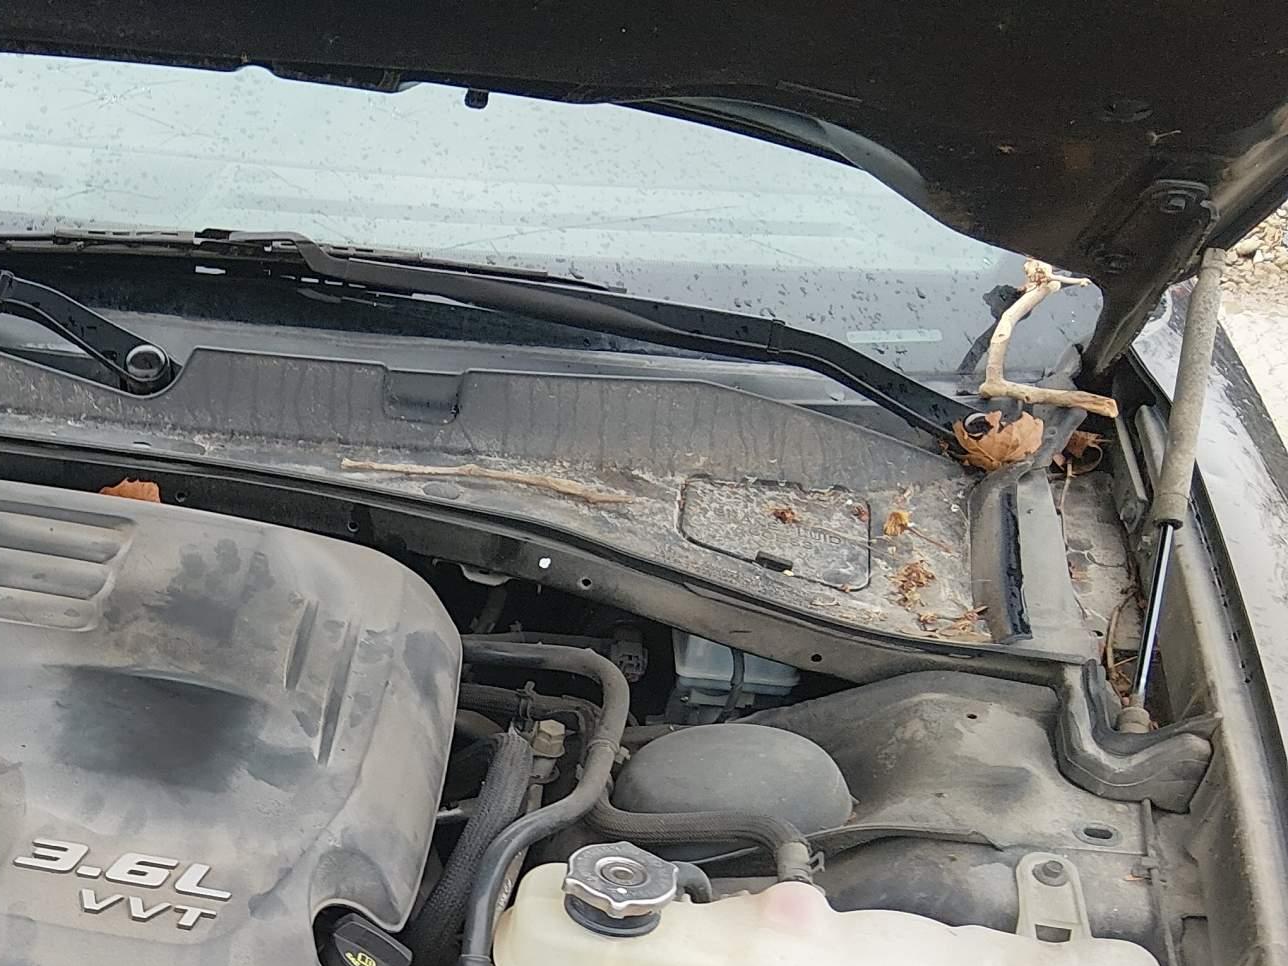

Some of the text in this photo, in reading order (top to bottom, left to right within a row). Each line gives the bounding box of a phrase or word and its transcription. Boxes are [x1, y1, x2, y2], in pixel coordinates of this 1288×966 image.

[786, 523, 842, 545] LUID
[13, 838, 233, 902] 3.6L
[79, 888, 217, 930] VVT
